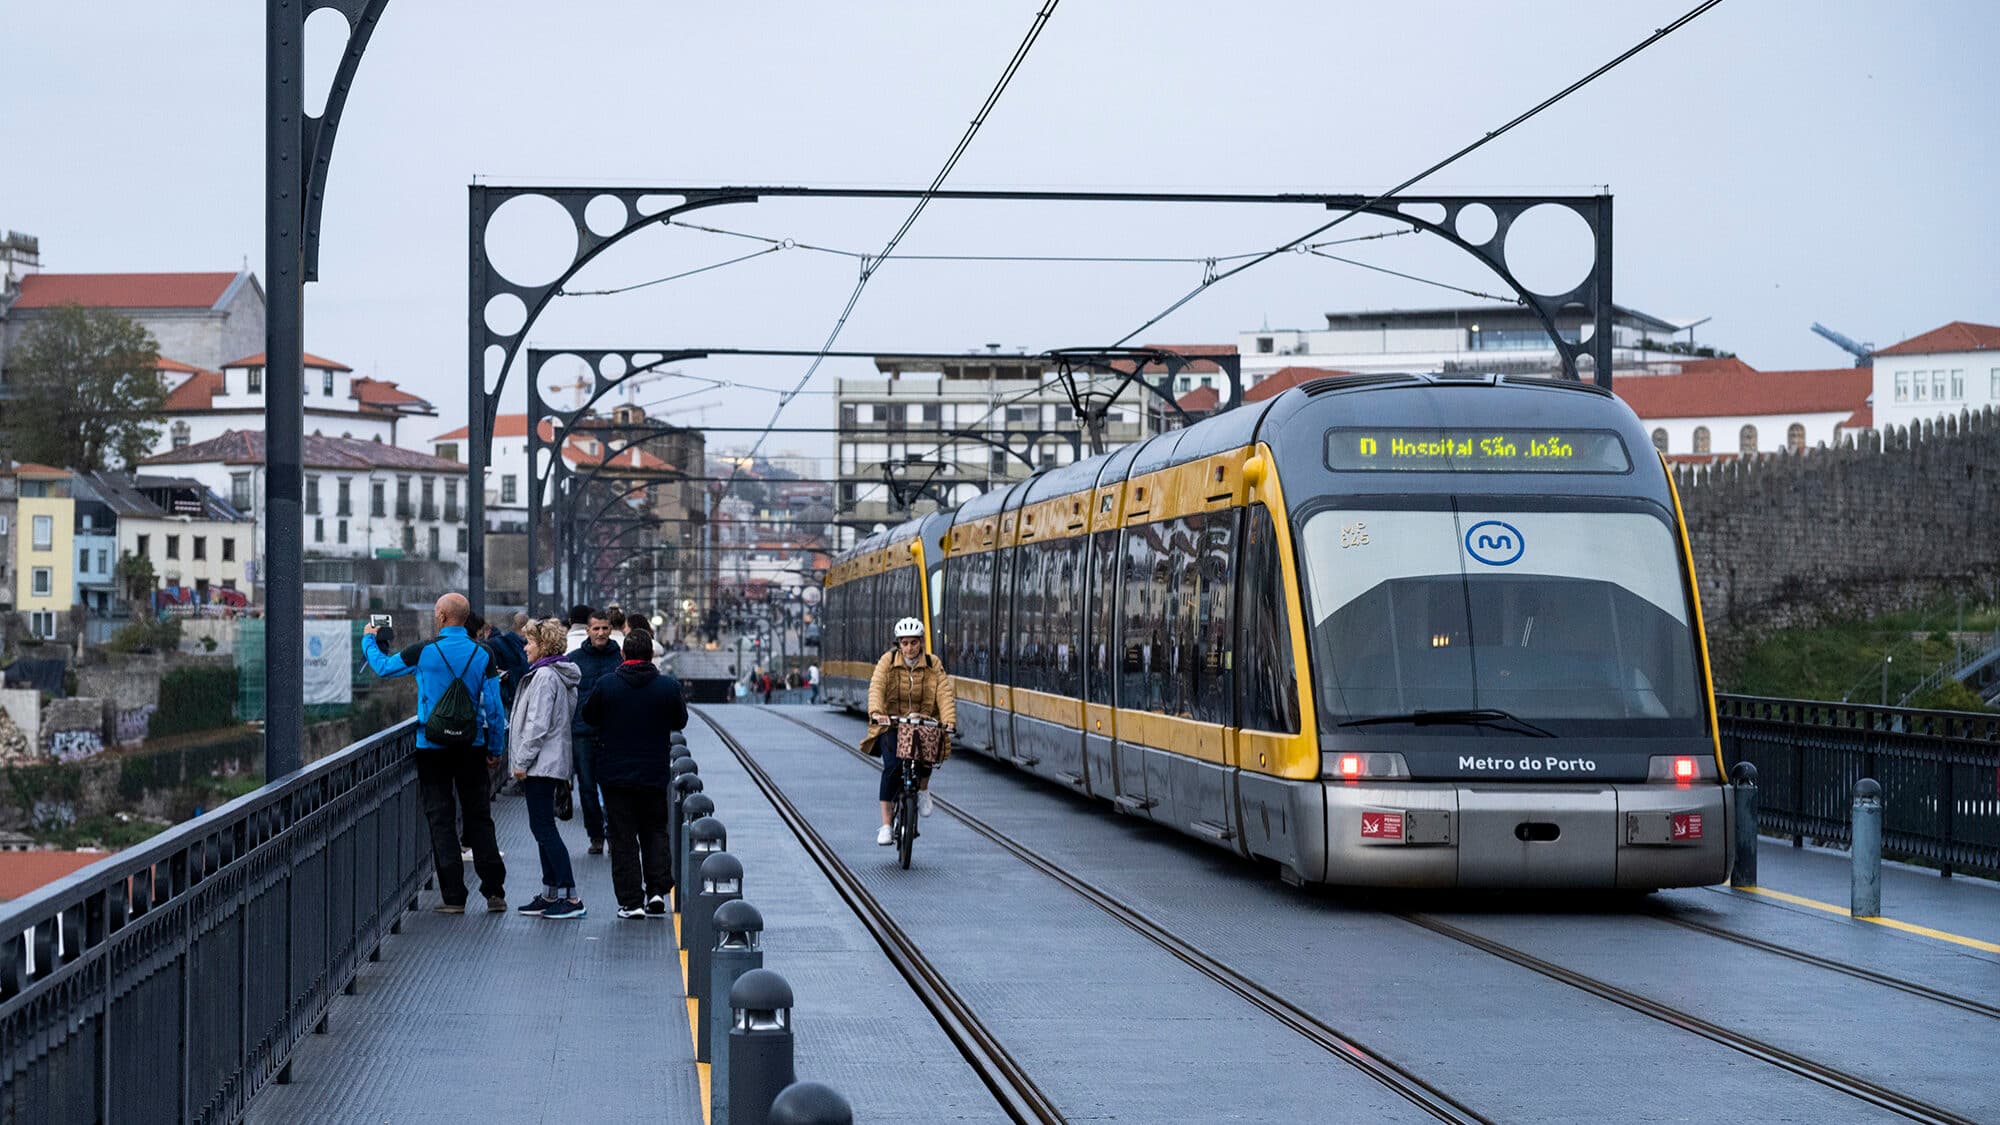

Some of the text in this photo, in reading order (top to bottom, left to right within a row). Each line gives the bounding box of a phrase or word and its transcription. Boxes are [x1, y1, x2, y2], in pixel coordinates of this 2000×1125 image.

[1391, 437, 1473, 456] Hospital
[1479, 436, 1517, 456] São
[1524, 436, 1573, 456] João
[1459, 755, 1597, 771] Metro do Porto
